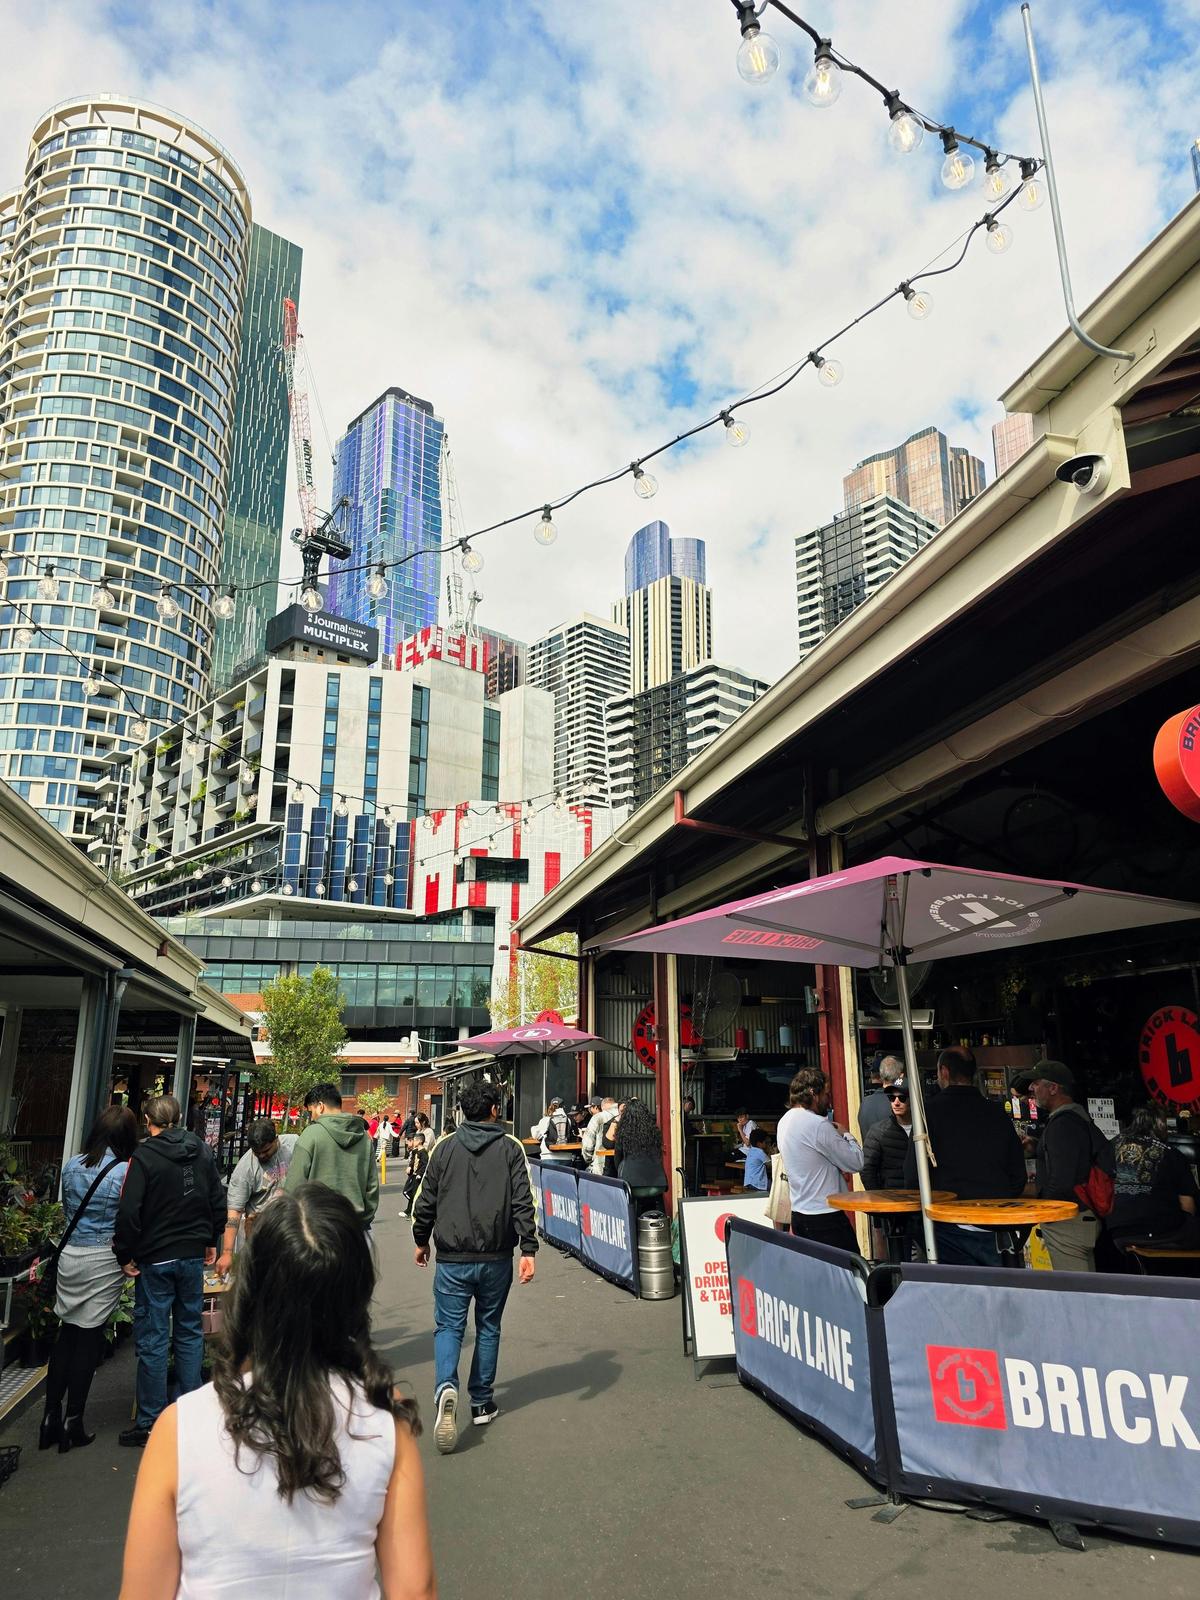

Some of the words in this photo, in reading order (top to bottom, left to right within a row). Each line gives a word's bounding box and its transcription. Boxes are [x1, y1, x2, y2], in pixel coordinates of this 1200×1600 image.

[303, 439, 313, 488] MULTIPLEX
[303, 624, 369, 652] MULTIPLEX
[314, 615, 348, 634] Journal
[1183, 711, 1200, 751] BRI
[589, 1208, 608, 1243] BRICK
[608, 1215, 626, 1250] LANE
[704, 1261, 728, 1274] OPE
[700, 1290, 709, 1302] &
[755, 1288, 802, 1361] BRICK
[803, 1310, 855, 1392] LANE
[1004, 1357, 1200, 1451] BRICK
